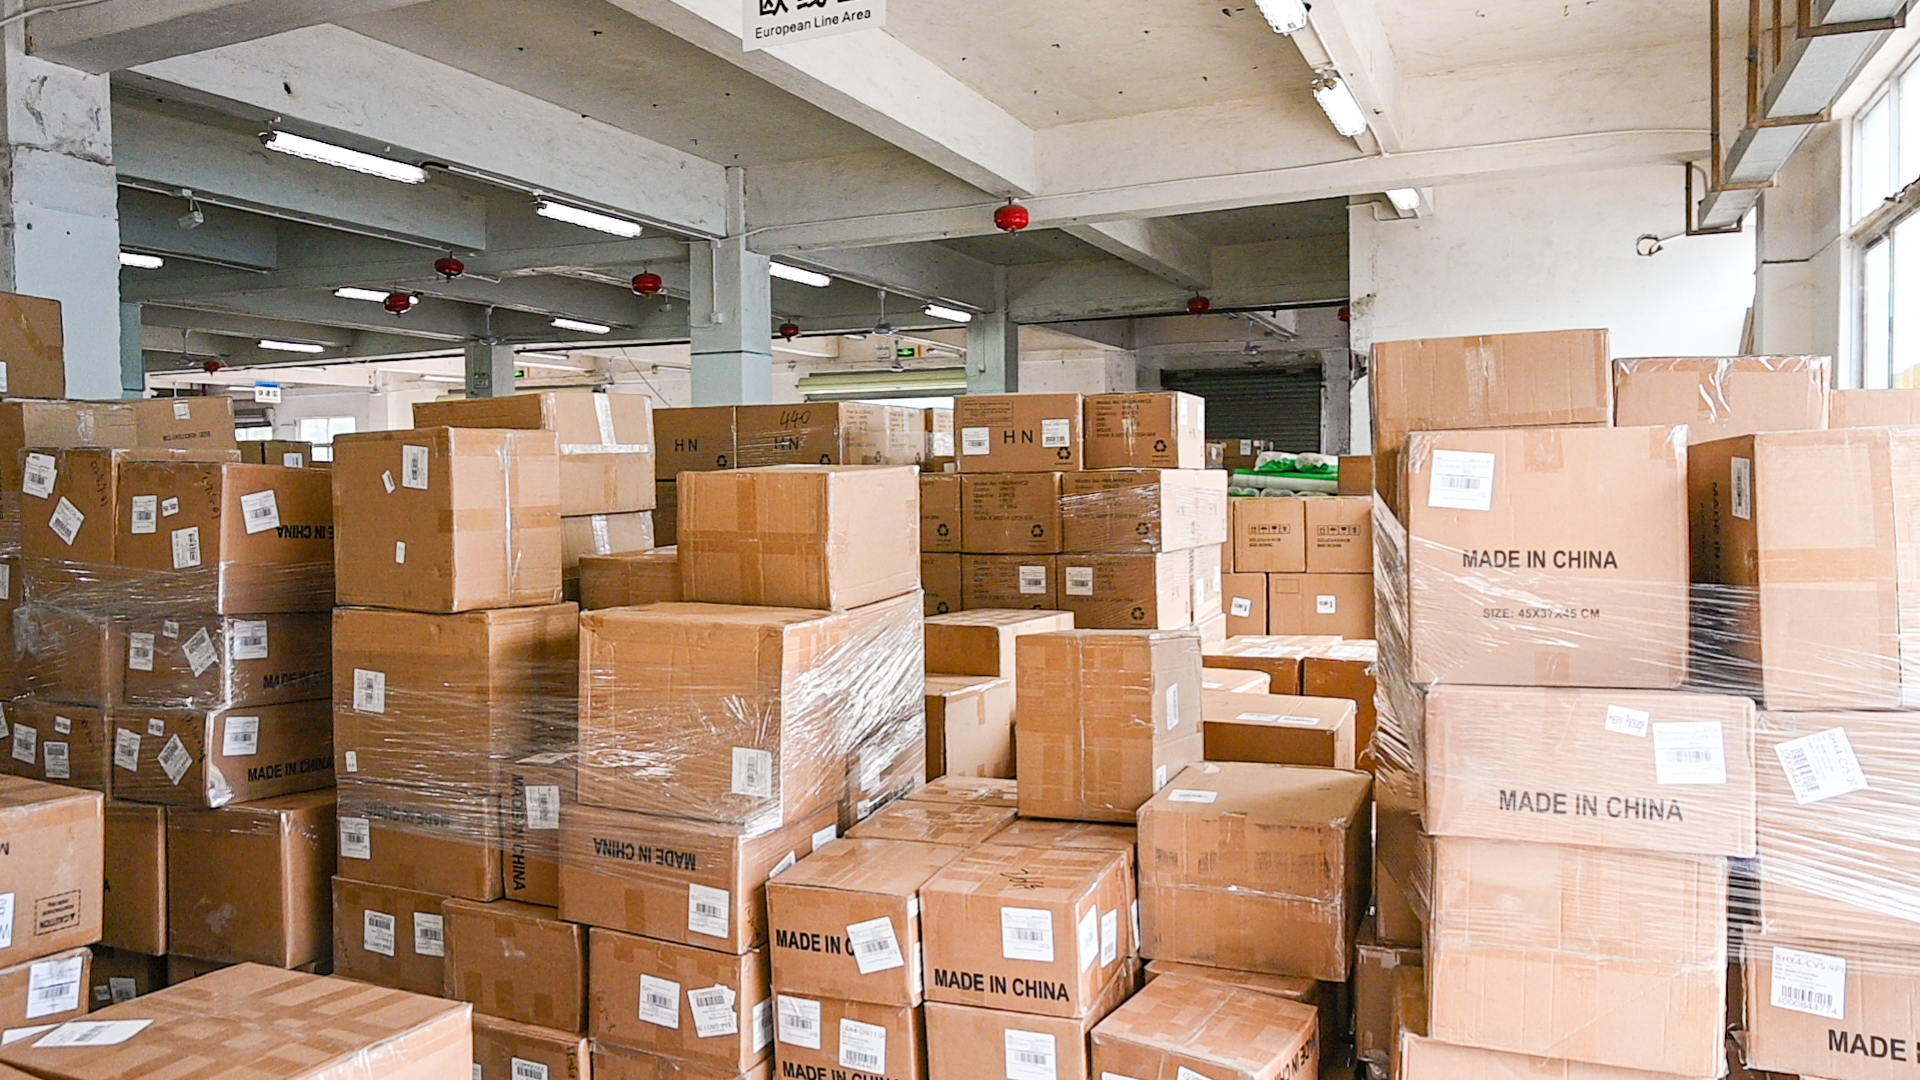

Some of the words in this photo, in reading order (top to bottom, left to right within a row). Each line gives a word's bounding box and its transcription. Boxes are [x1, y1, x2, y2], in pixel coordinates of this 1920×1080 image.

[755, 20, 811, 39] European
[814, 15, 839, 28] Line
[842, 9, 871, 23] Area
[779, 410, 811, 428] 440
[277, 525, 311, 539] CHINA
[314, 525, 326, 539] IN
[1463, 550, 1520, 568] MADE
[1528, 550, 1545, 568] IN
[1553, 550, 1618, 569] CHINA
[1581, 608, 1600, 619] CM
[248, 764, 282, 782] MADE
[284, 762, 297, 776] IN
[1499, 789, 1567, 814] MADE
[1576, 794, 1597, 816] IN
[1606, 797, 1683, 821] CHINA
[593, 838, 635, 860] CHINA
[639, 845, 651, 864] IN
[655, 848, 696, 871] MADE
[511, 845, 527, 891] CHINA
[776, 929, 821, 952] MADE
[825, 935, 841, 954] IN
[934, 968, 985, 992] MADE
[989, 975, 1007, 995] IN
[1012, 978, 1070, 1002] CHINA
[1828, 1029, 1907, 1062] MADE
[782, 1061, 827, 1080] MADE
